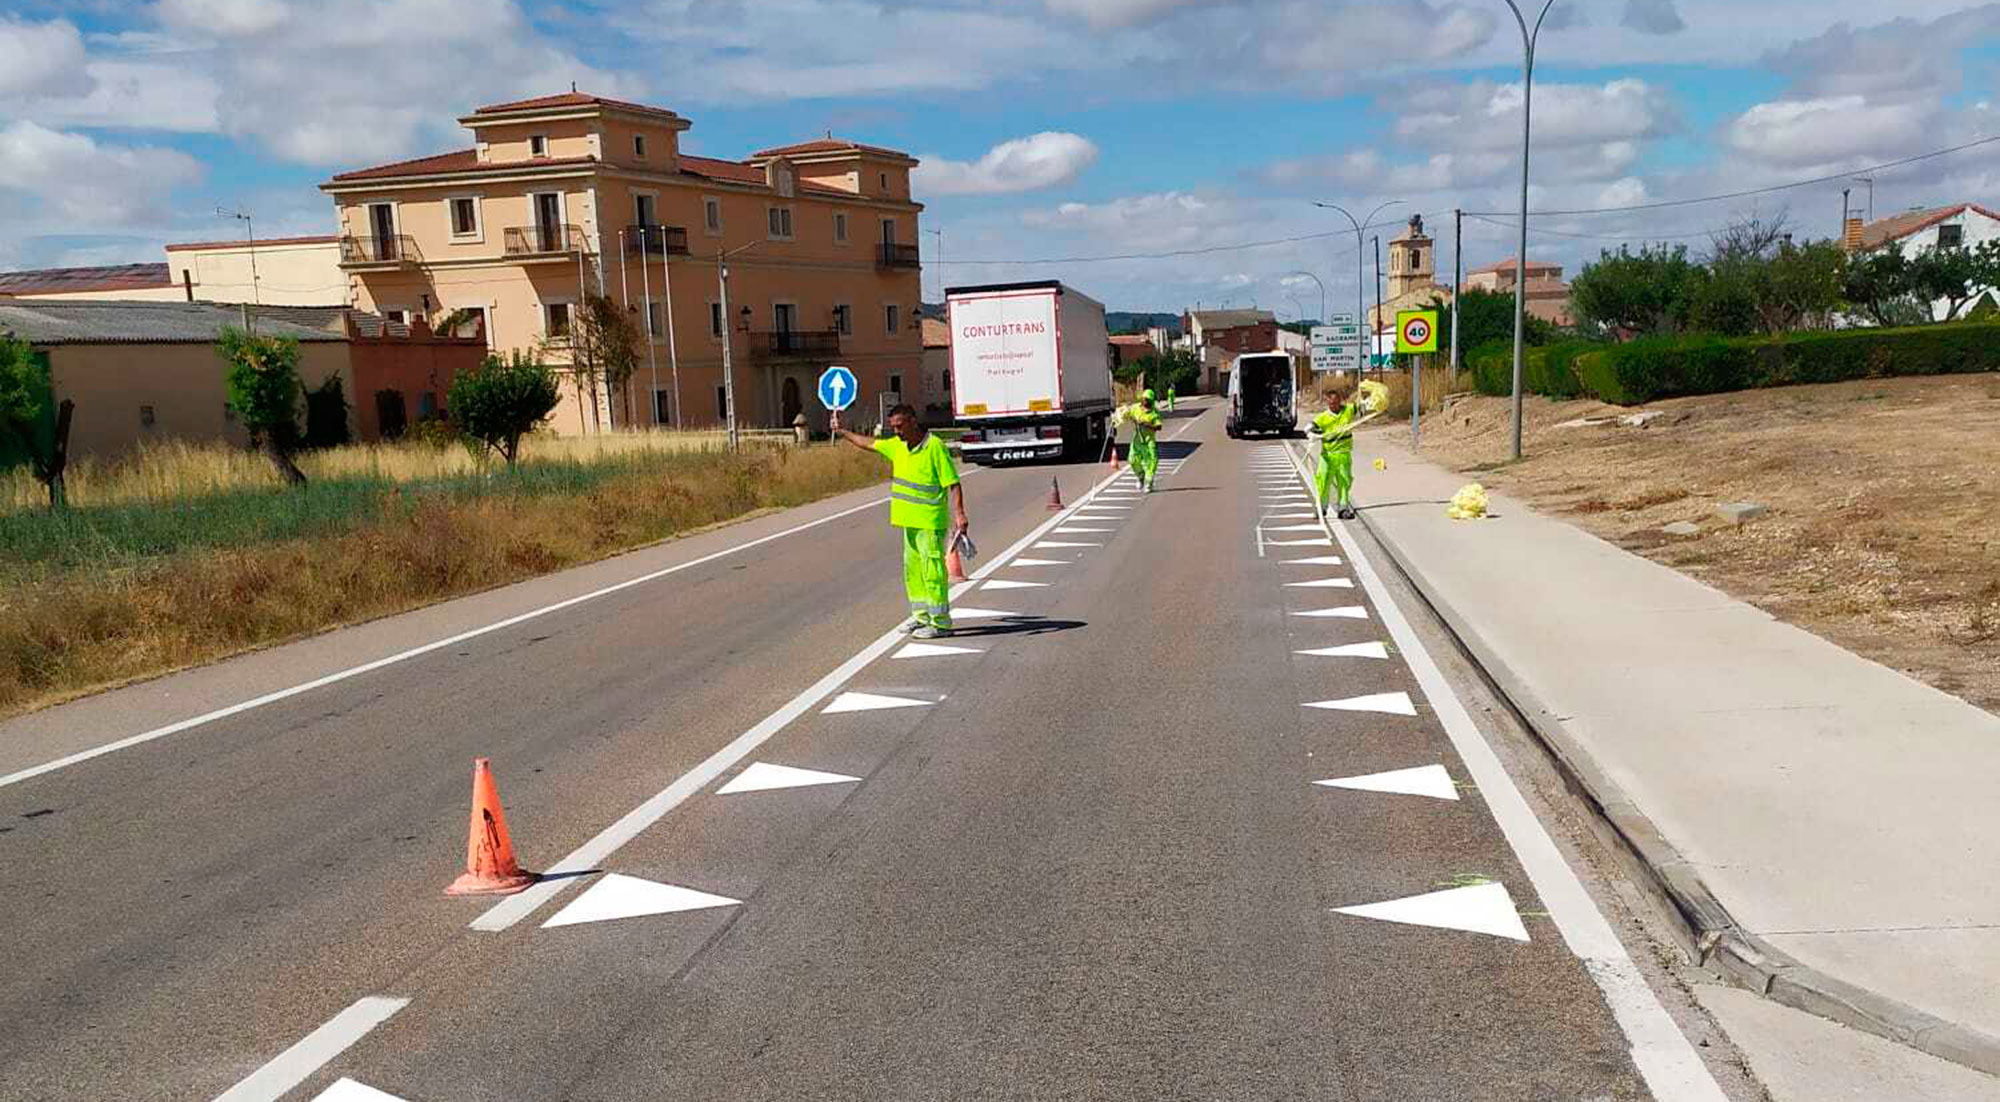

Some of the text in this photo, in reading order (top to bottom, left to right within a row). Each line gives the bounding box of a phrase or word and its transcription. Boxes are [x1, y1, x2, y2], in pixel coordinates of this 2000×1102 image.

[962, 321, 1046, 338] CONTURTRANS
[1409, 327, 1426, 337] 40
[1326, 334, 1368, 342] SACRAMEA
